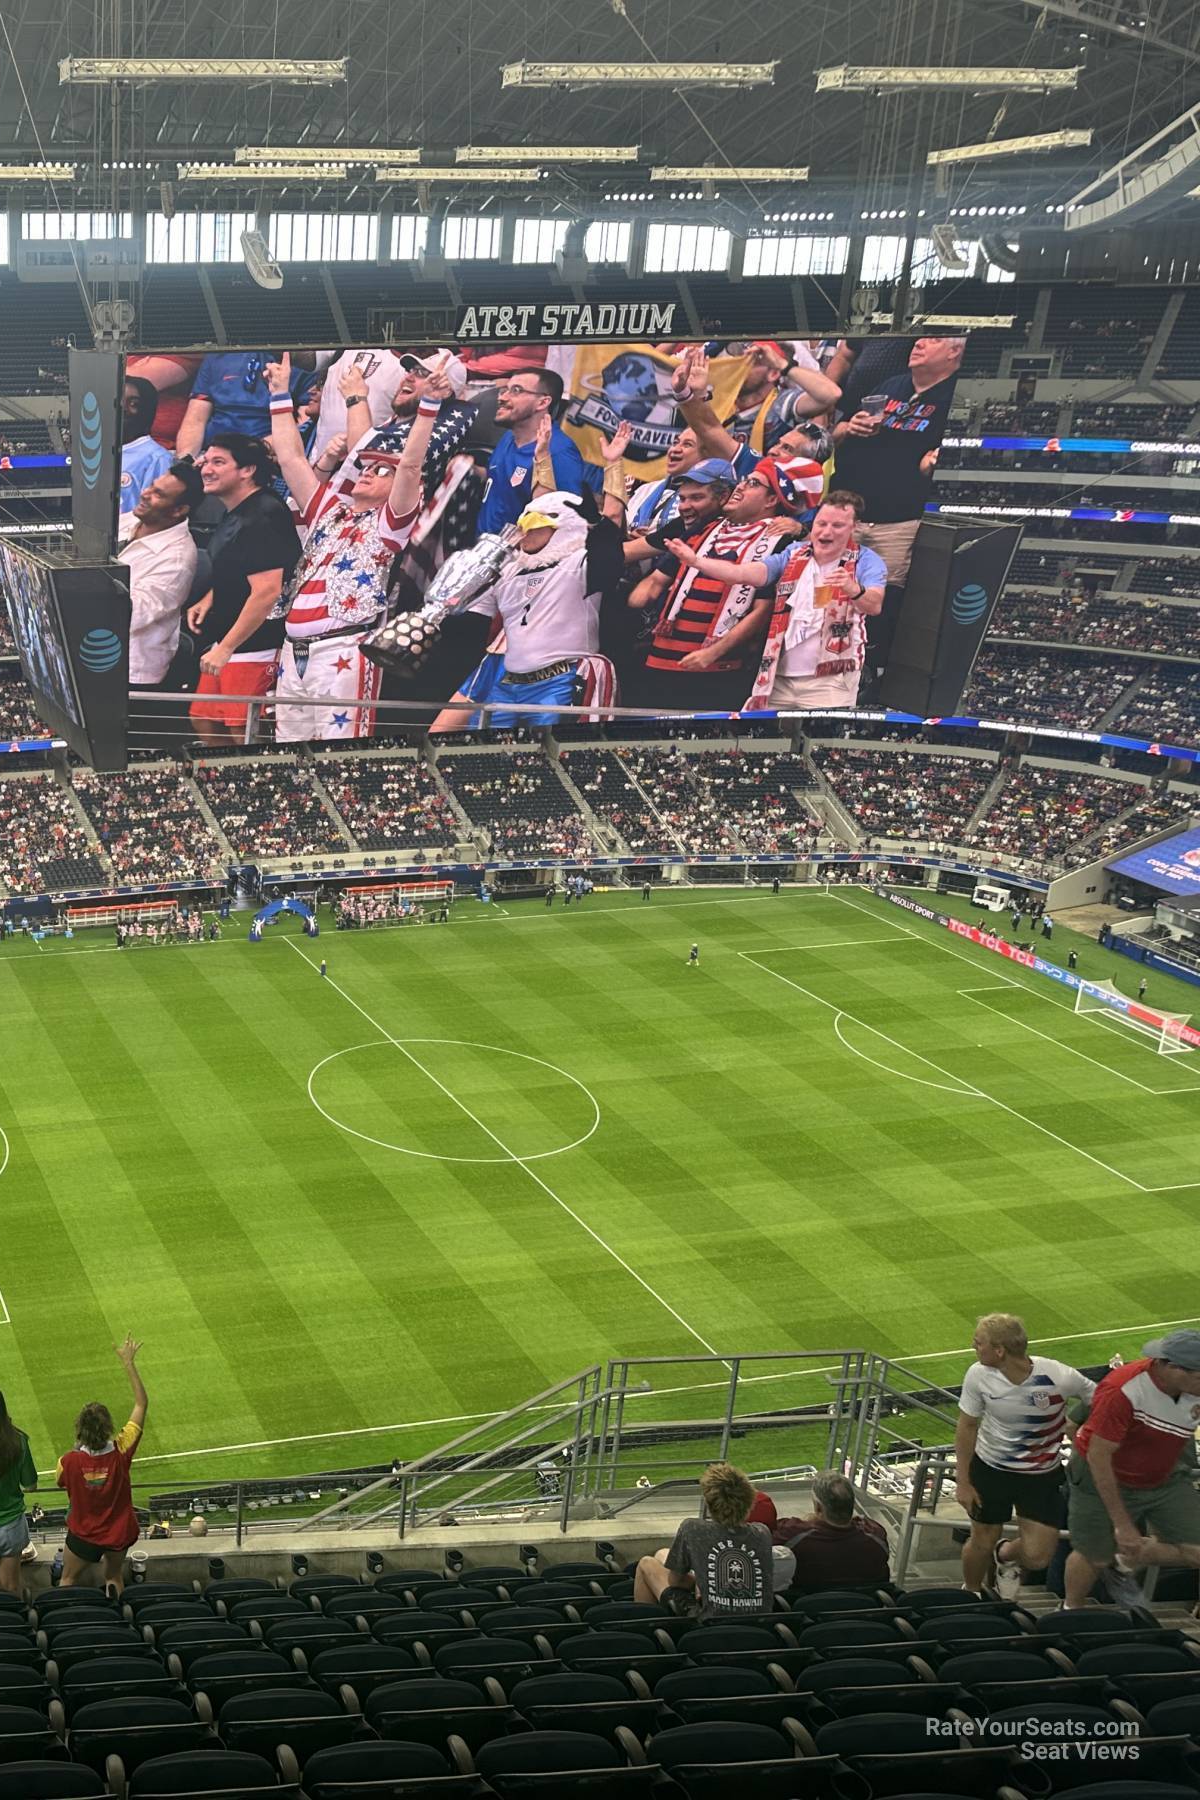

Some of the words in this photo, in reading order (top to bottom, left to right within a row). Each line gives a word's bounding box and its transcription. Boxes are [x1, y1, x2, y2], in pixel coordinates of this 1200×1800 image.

[456, 305, 536, 337] AT&T
[540, 303, 676, 336] STADIUM
[595, 407, 618, 428] FOO
[889, 893, 915, 910] ABSOLUT
[915, 905, 935, 920] SPORT
[949, 918, 973, 940] TCL
[979, 932, 1003, 953] TCL
[1010, 946, 1035, 968] TCL
[708, 1540, 734, 1594] PARADISE
[708, 1594, 730, 1606] MAUI
[733, 1598, 763, 1607] HAWAII
